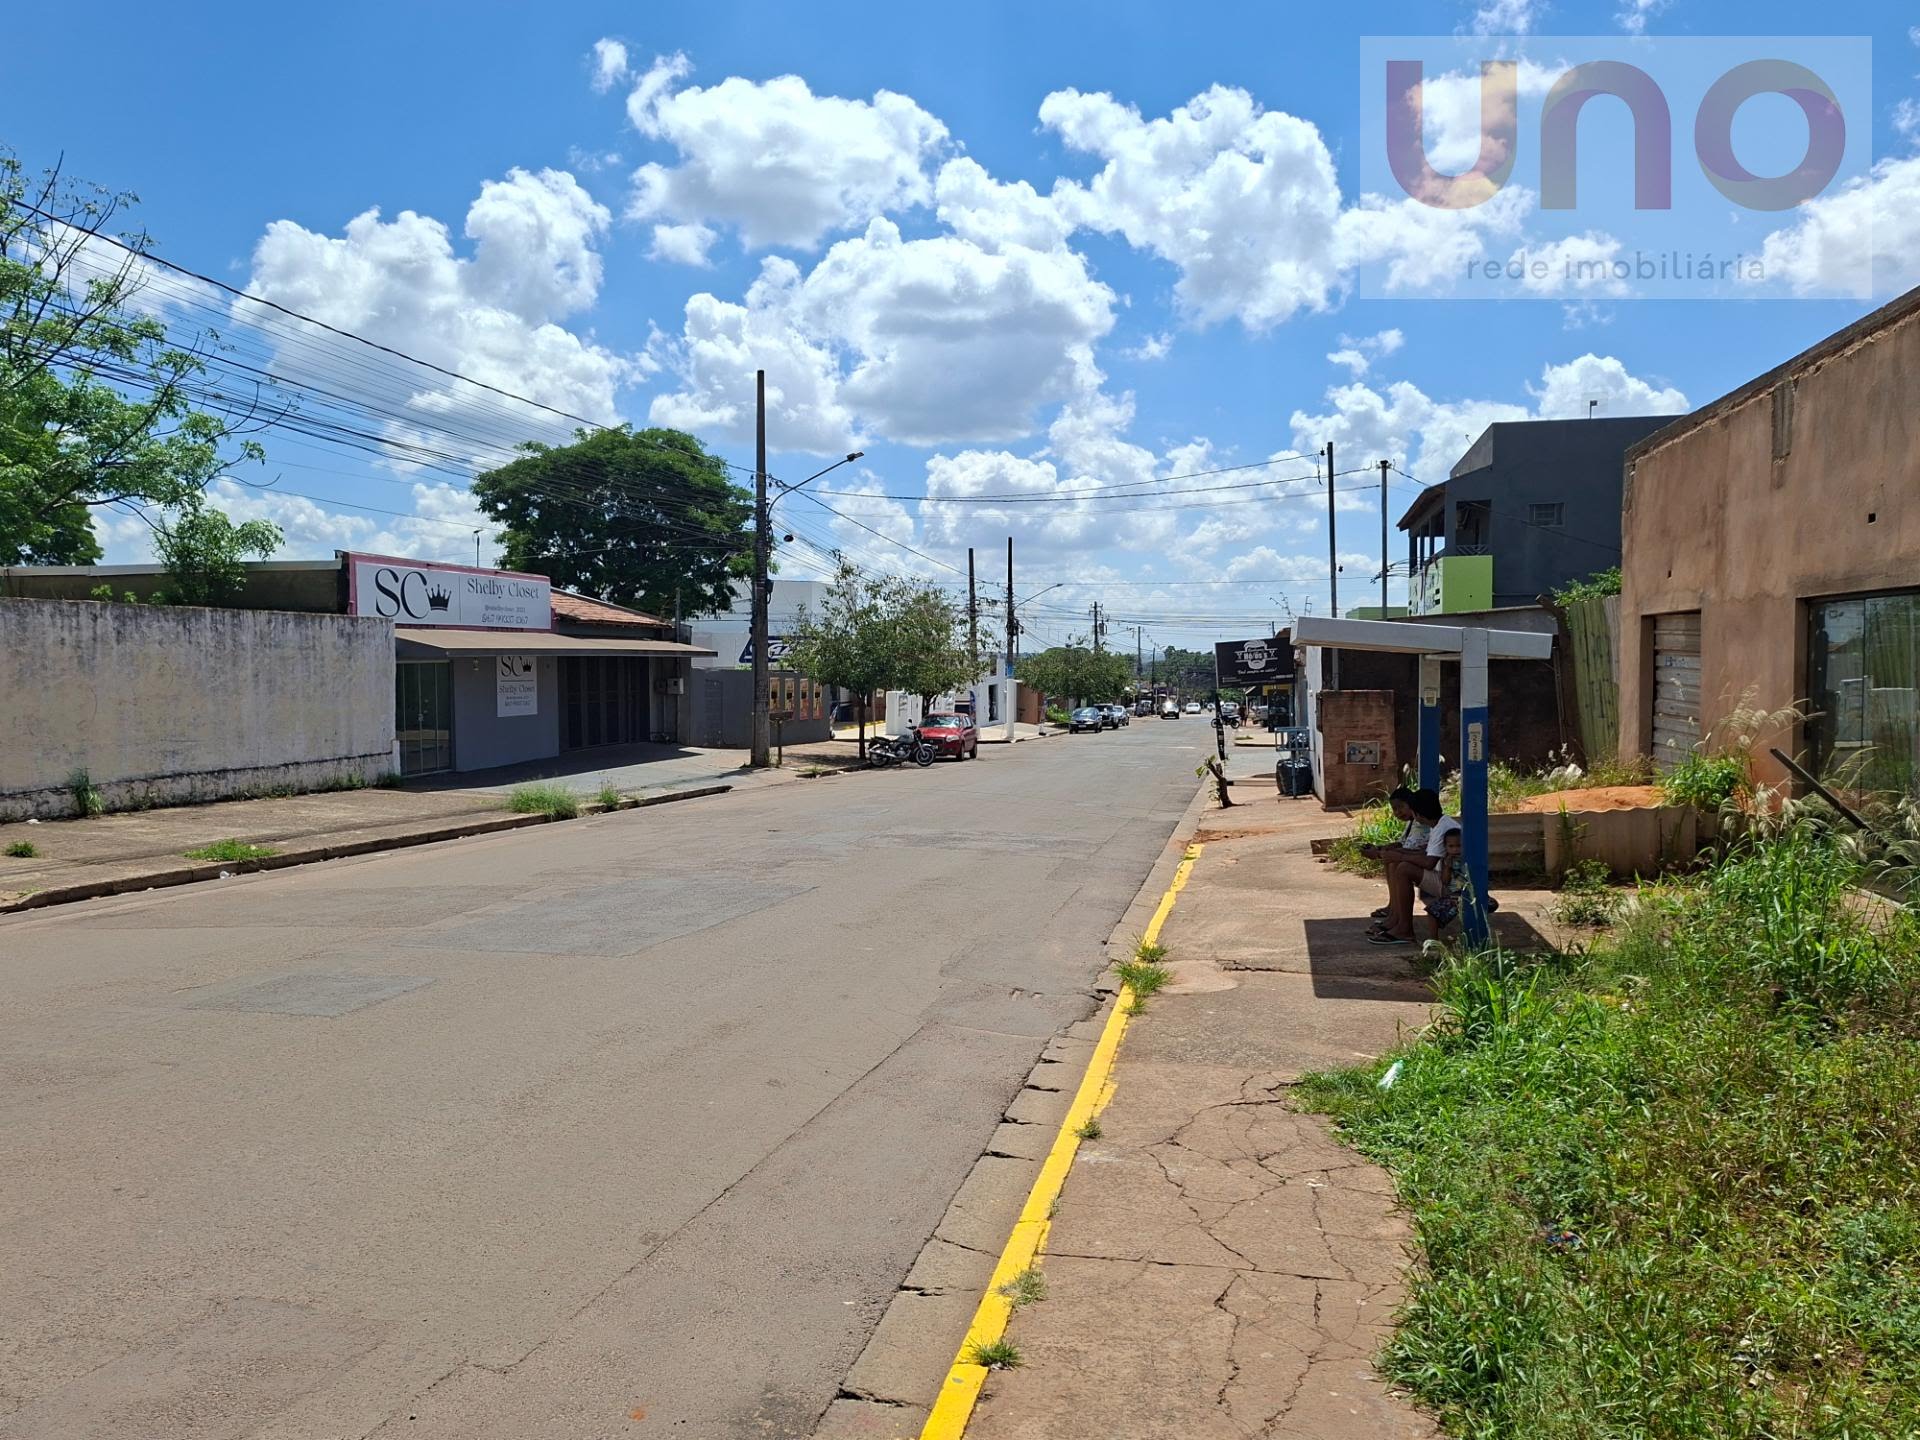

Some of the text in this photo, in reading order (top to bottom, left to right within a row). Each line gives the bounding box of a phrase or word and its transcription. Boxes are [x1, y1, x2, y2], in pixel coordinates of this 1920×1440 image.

[374, 567, 430, 619] SC
[467, 577, 539, 599] Shelby Closet
